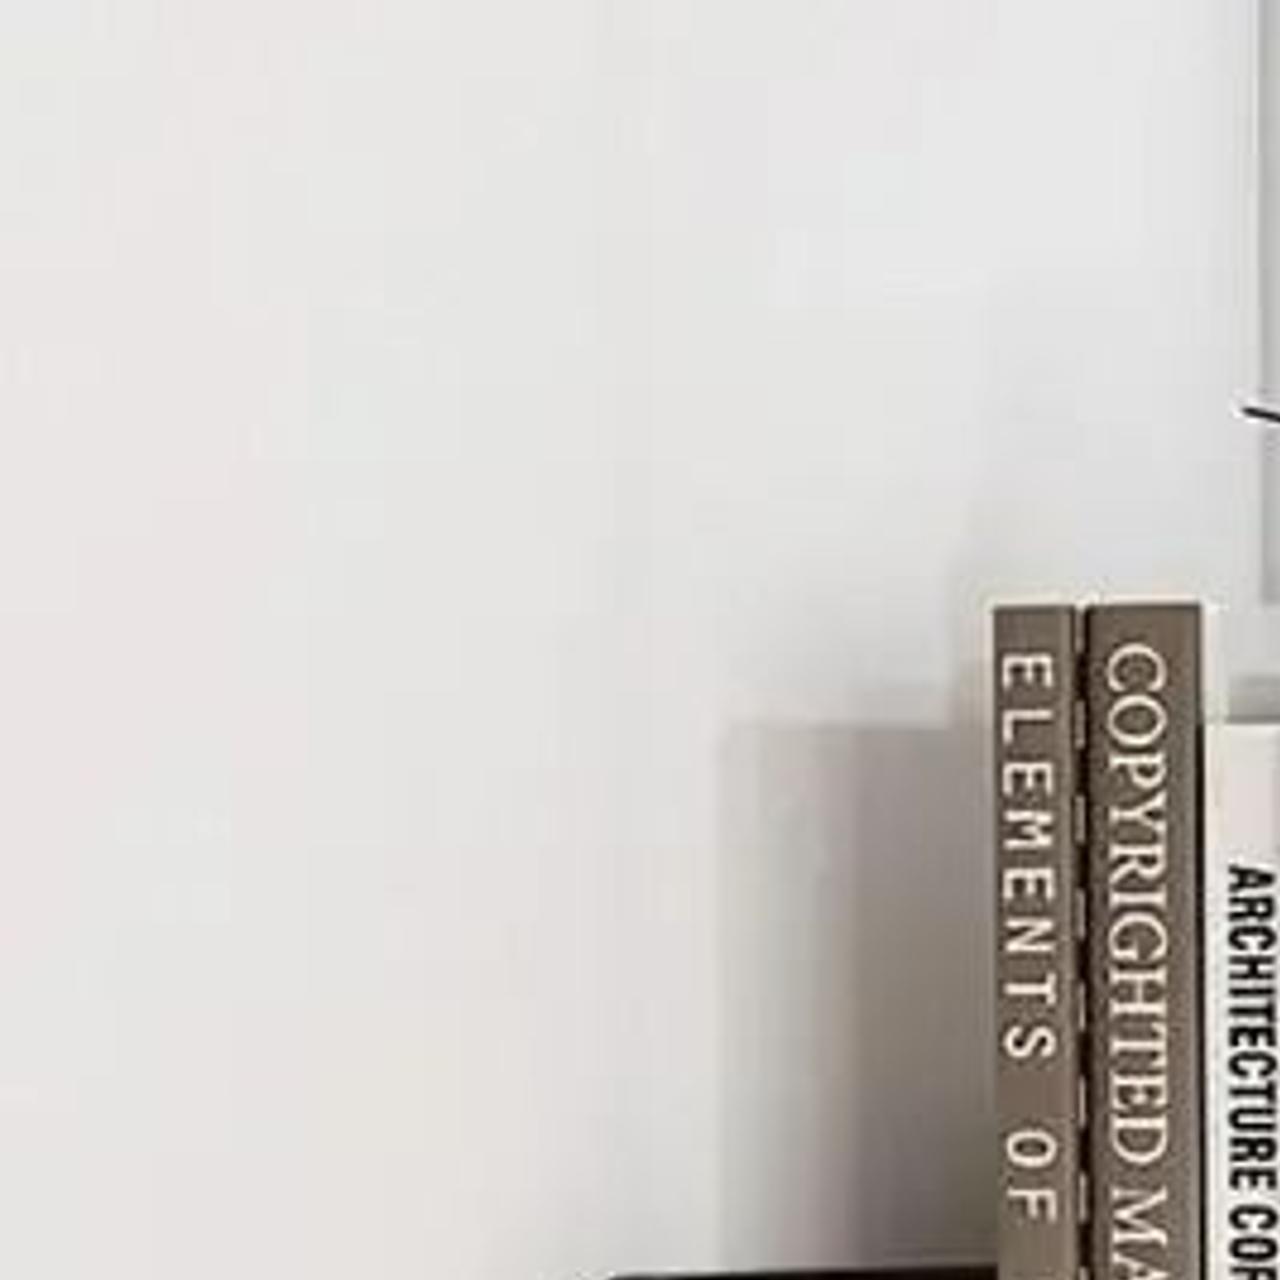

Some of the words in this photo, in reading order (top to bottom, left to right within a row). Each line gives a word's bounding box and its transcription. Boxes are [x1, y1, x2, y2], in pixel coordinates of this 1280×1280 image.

[1001, 652, 1057, 1060] ELEMENTS
[1106, 641, 1170, 1164] COPYRIGHTED
[1226, 863, 1280, 1192] ARCHITECTURE
[1005, 1129, 1057, 1222] OF
